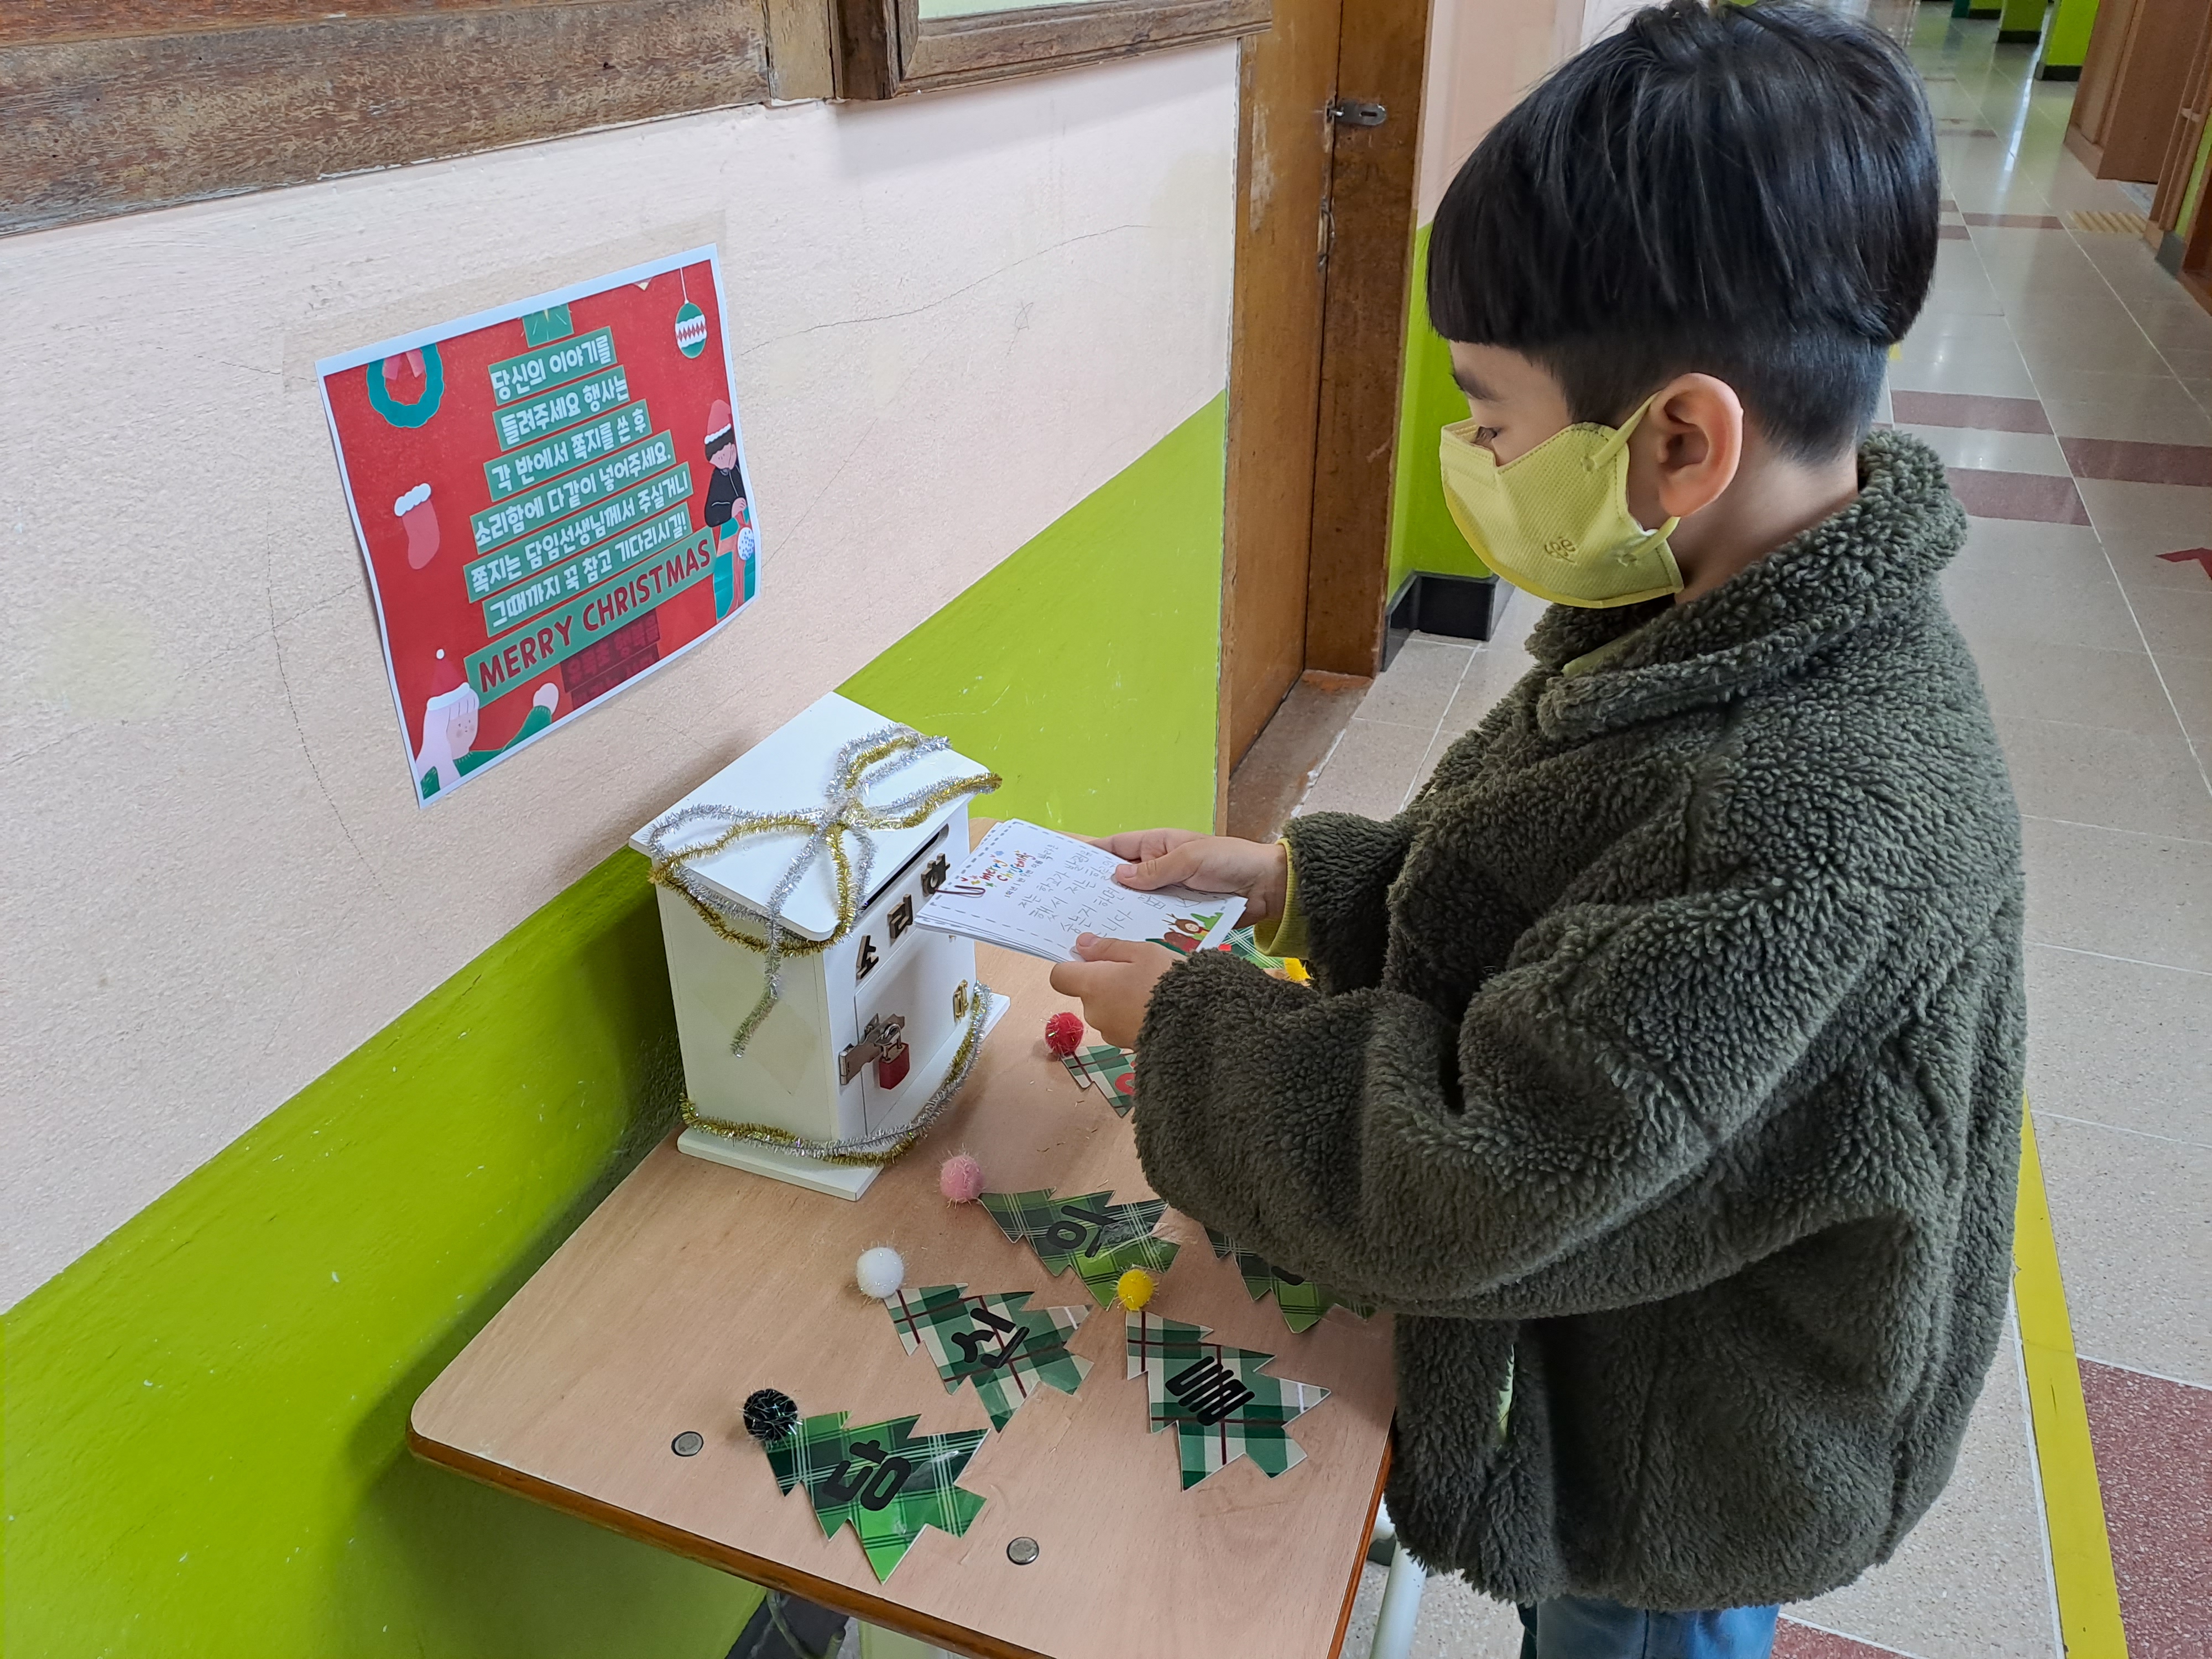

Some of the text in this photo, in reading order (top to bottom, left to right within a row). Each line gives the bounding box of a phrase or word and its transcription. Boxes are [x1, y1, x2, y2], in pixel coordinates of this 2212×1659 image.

[491, 335, 612, 400] 당신의 이야기를
[492, 408, 646, 492] 각 반에서 쪽지를 쓴 후
[501, 376, 629, 445] 들려주세요 행사는
[471, 471, 688, 593] 쪽지는 담임선생님께서 주실거니
[476, 442, 671, 547] 소리함에 다같이 넣어주세요.
[491, 512, 687, 627] 그때까지 꾹 참고 기다리시길!
[479, 615, 572, 692] MERRY
[583, 540, 710, 632] CHRISTMAS
[1036, 870, 1070, 892] 학교가
[821, 1439, 912, 1511] 당
